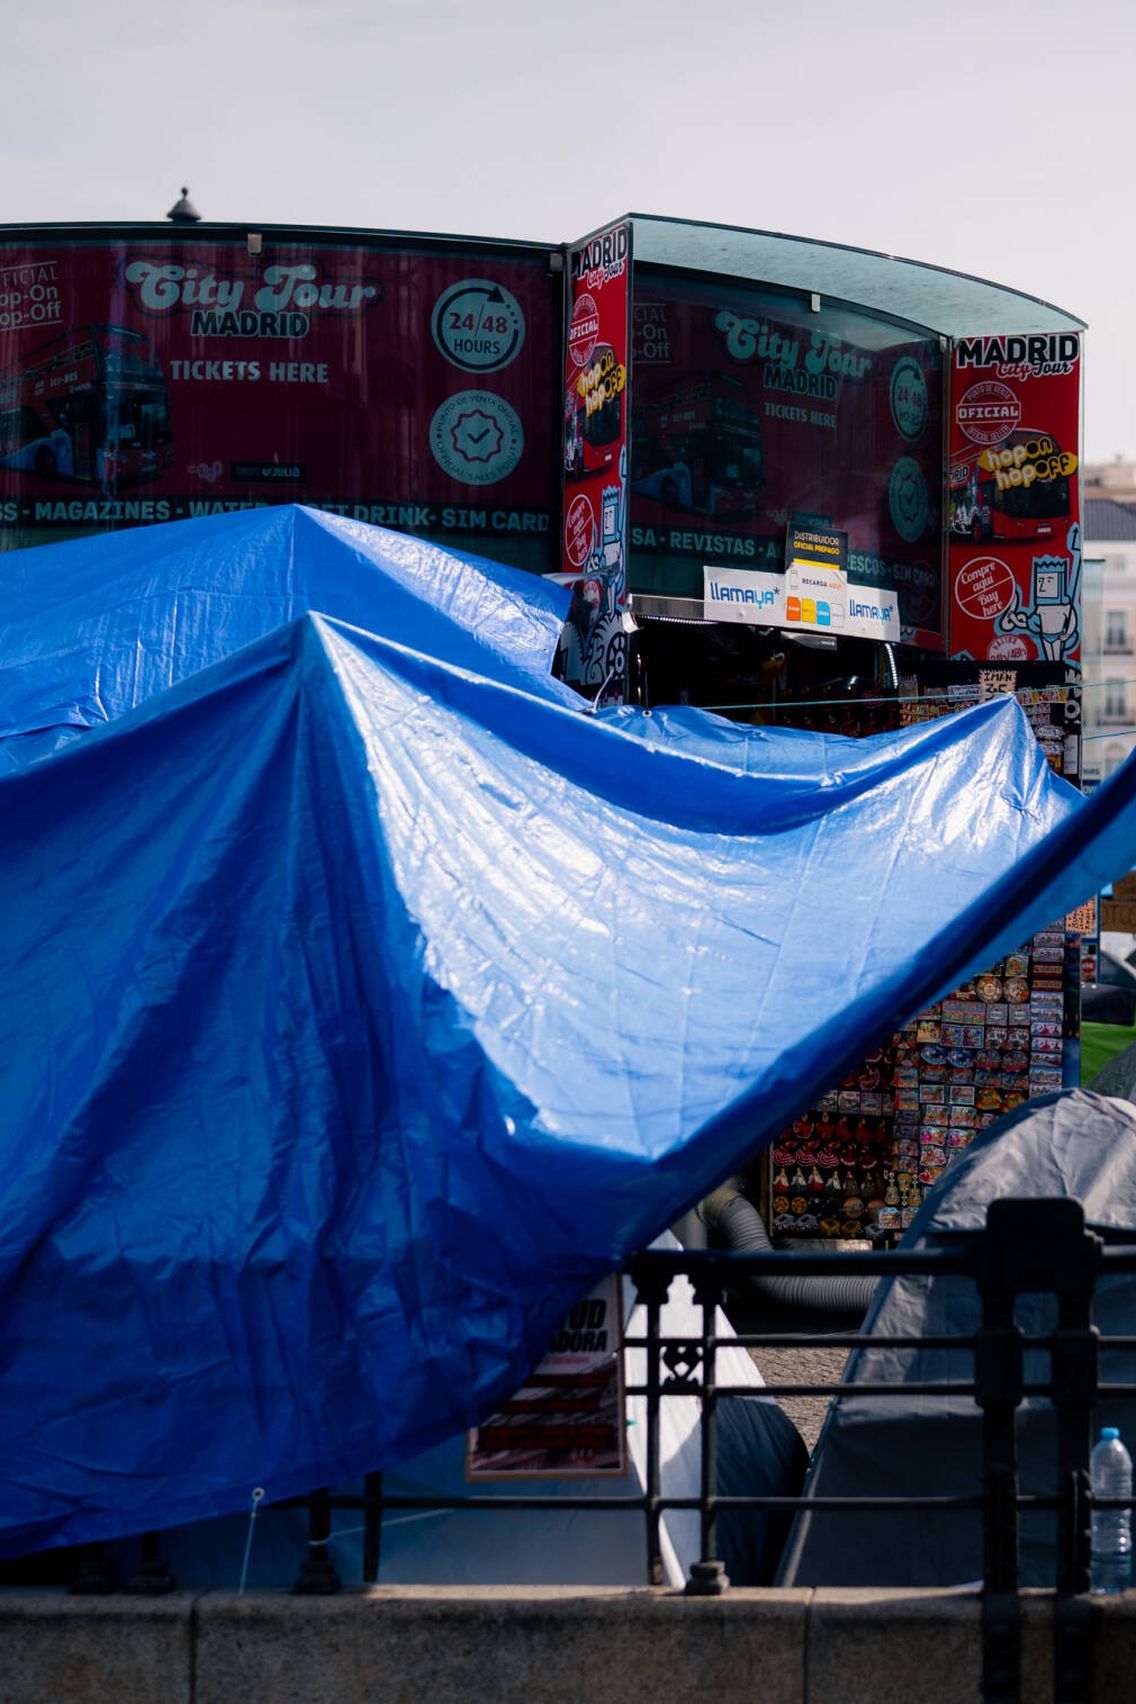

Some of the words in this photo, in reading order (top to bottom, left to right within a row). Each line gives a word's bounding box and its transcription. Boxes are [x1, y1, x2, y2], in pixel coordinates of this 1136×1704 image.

[125, 261, 244, 312] City
[254, 263, 377, 313] Tour
[191, 311, 309, 338] MADRID
[449, 304, 508, 337] 24/48
[454, 338, 500, 355] HOURS
[715, 311, 799, 369] City
[804, 331, 872, 378] Tour
[956, 334, 1079, 368] MADRID
[170, 359, 261, 382] TICKETS
[268, 361, 328, 383] HERE
[764, 363, 837, 400] MADRID
[1032, 361, 1073, 377] Tour
[764, 401, 808, 423] TICKETS
[810, 411, 837, 429] HERE
[959, 406, 1019, 419] OFICIAL
[34, 500, 171, 521] MAGAZINES
[441, 508, 487, 530] SIM
[490, 511, 549, 532] CARD
[670, 530, 755, 557] REVISTAS
[960, 562, 996, 585] Compre
[978, 591, 999, 606] Buy
[982, 601, 1003, 617] here
